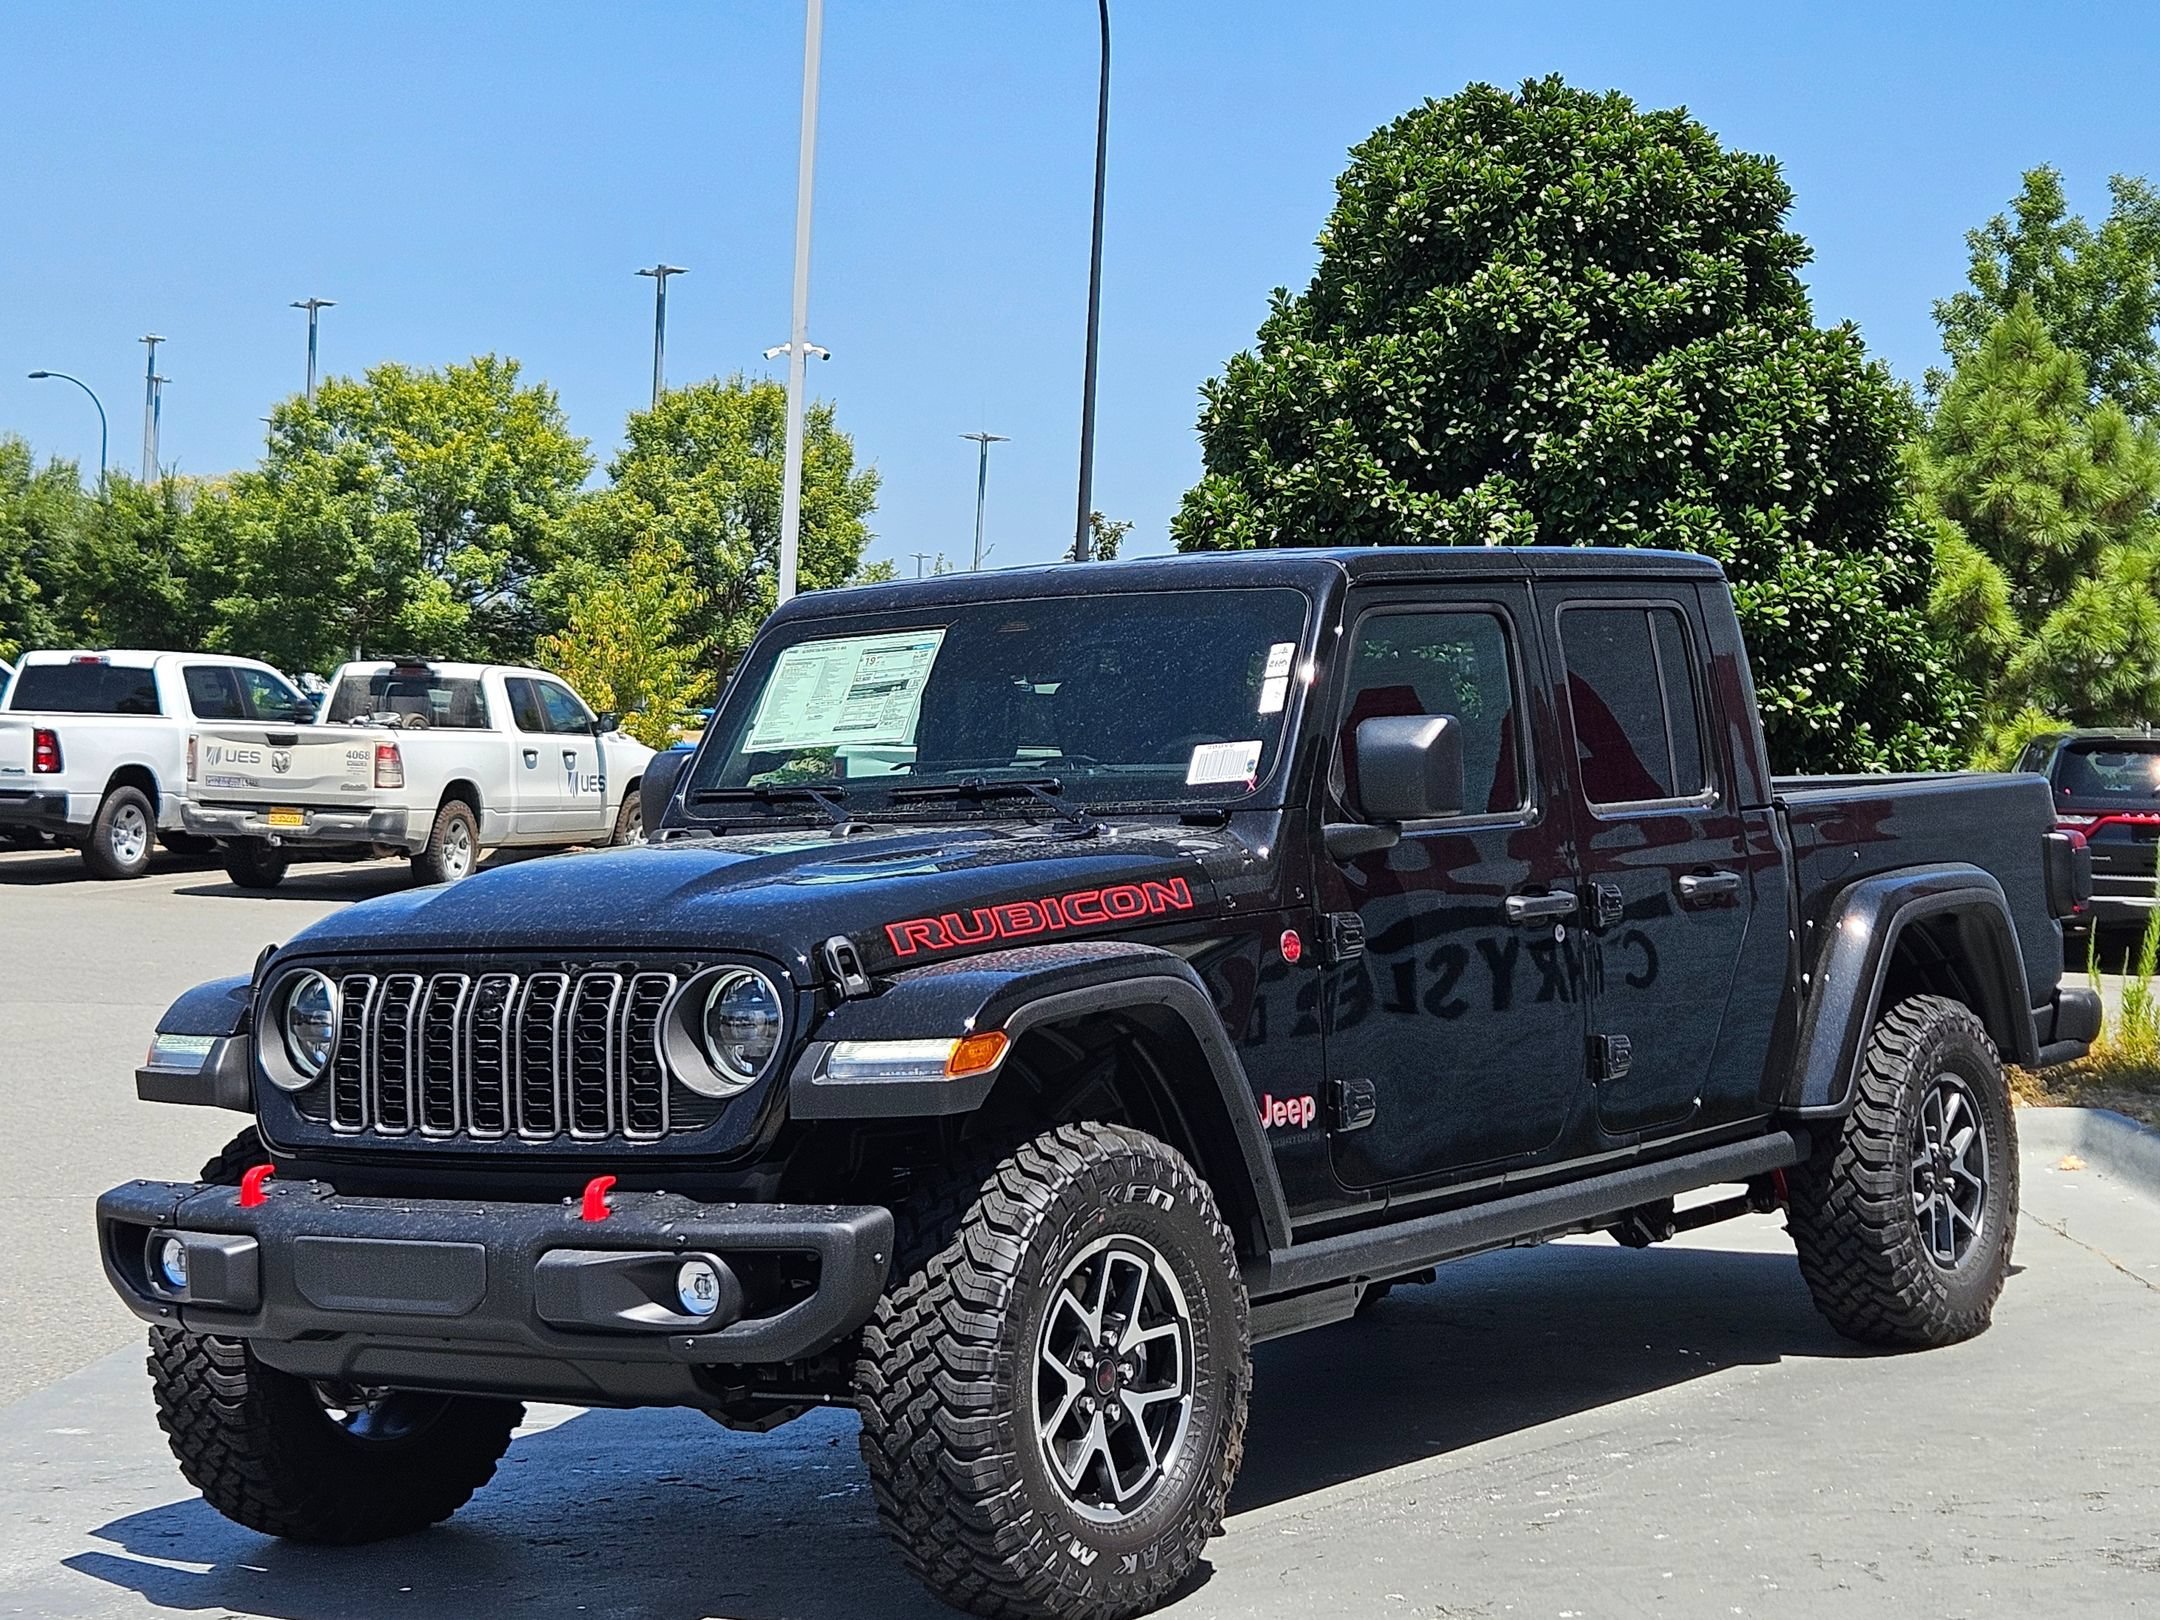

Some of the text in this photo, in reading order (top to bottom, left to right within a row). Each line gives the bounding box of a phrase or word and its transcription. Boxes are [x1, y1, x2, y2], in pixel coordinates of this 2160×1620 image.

[864, 656, 877, 666] 19
[226, 751, 262, 764] UES
[346, 750, 371, 760] 4068
[581, 774, 606, 792] UES
[885, 877, 1193, 957] RUBICON
[1259, 1094, 1316, 1129] Jeep
